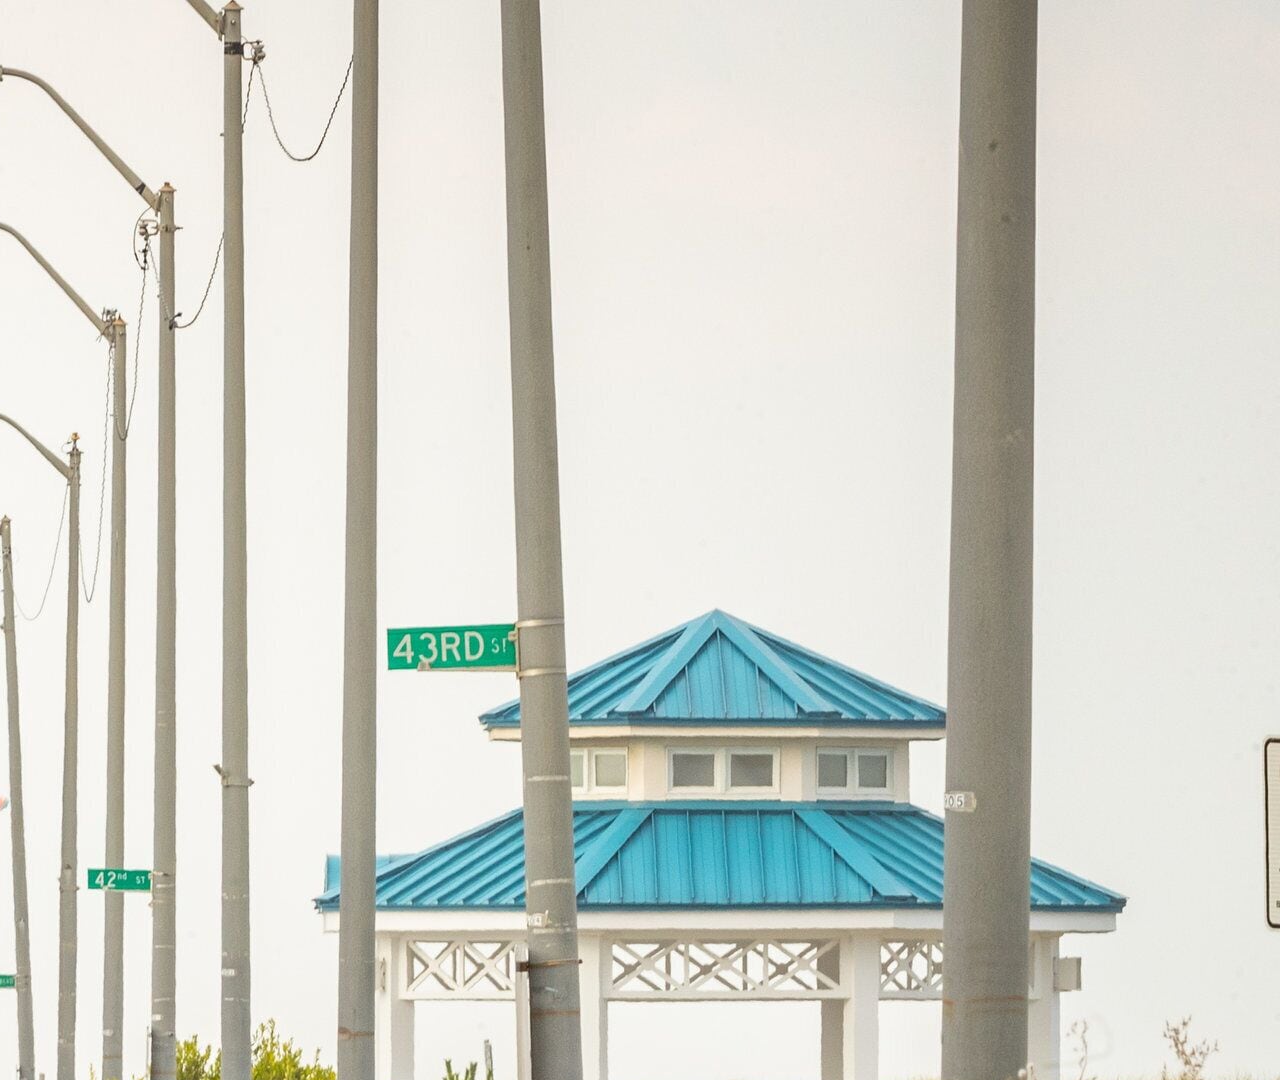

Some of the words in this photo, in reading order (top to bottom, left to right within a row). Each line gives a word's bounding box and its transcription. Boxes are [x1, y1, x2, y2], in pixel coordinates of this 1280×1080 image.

[393, 631, 485, 664] 43RD
[95, 871, 128, 888] 42nd
[135, 875, 146, 885] ST
